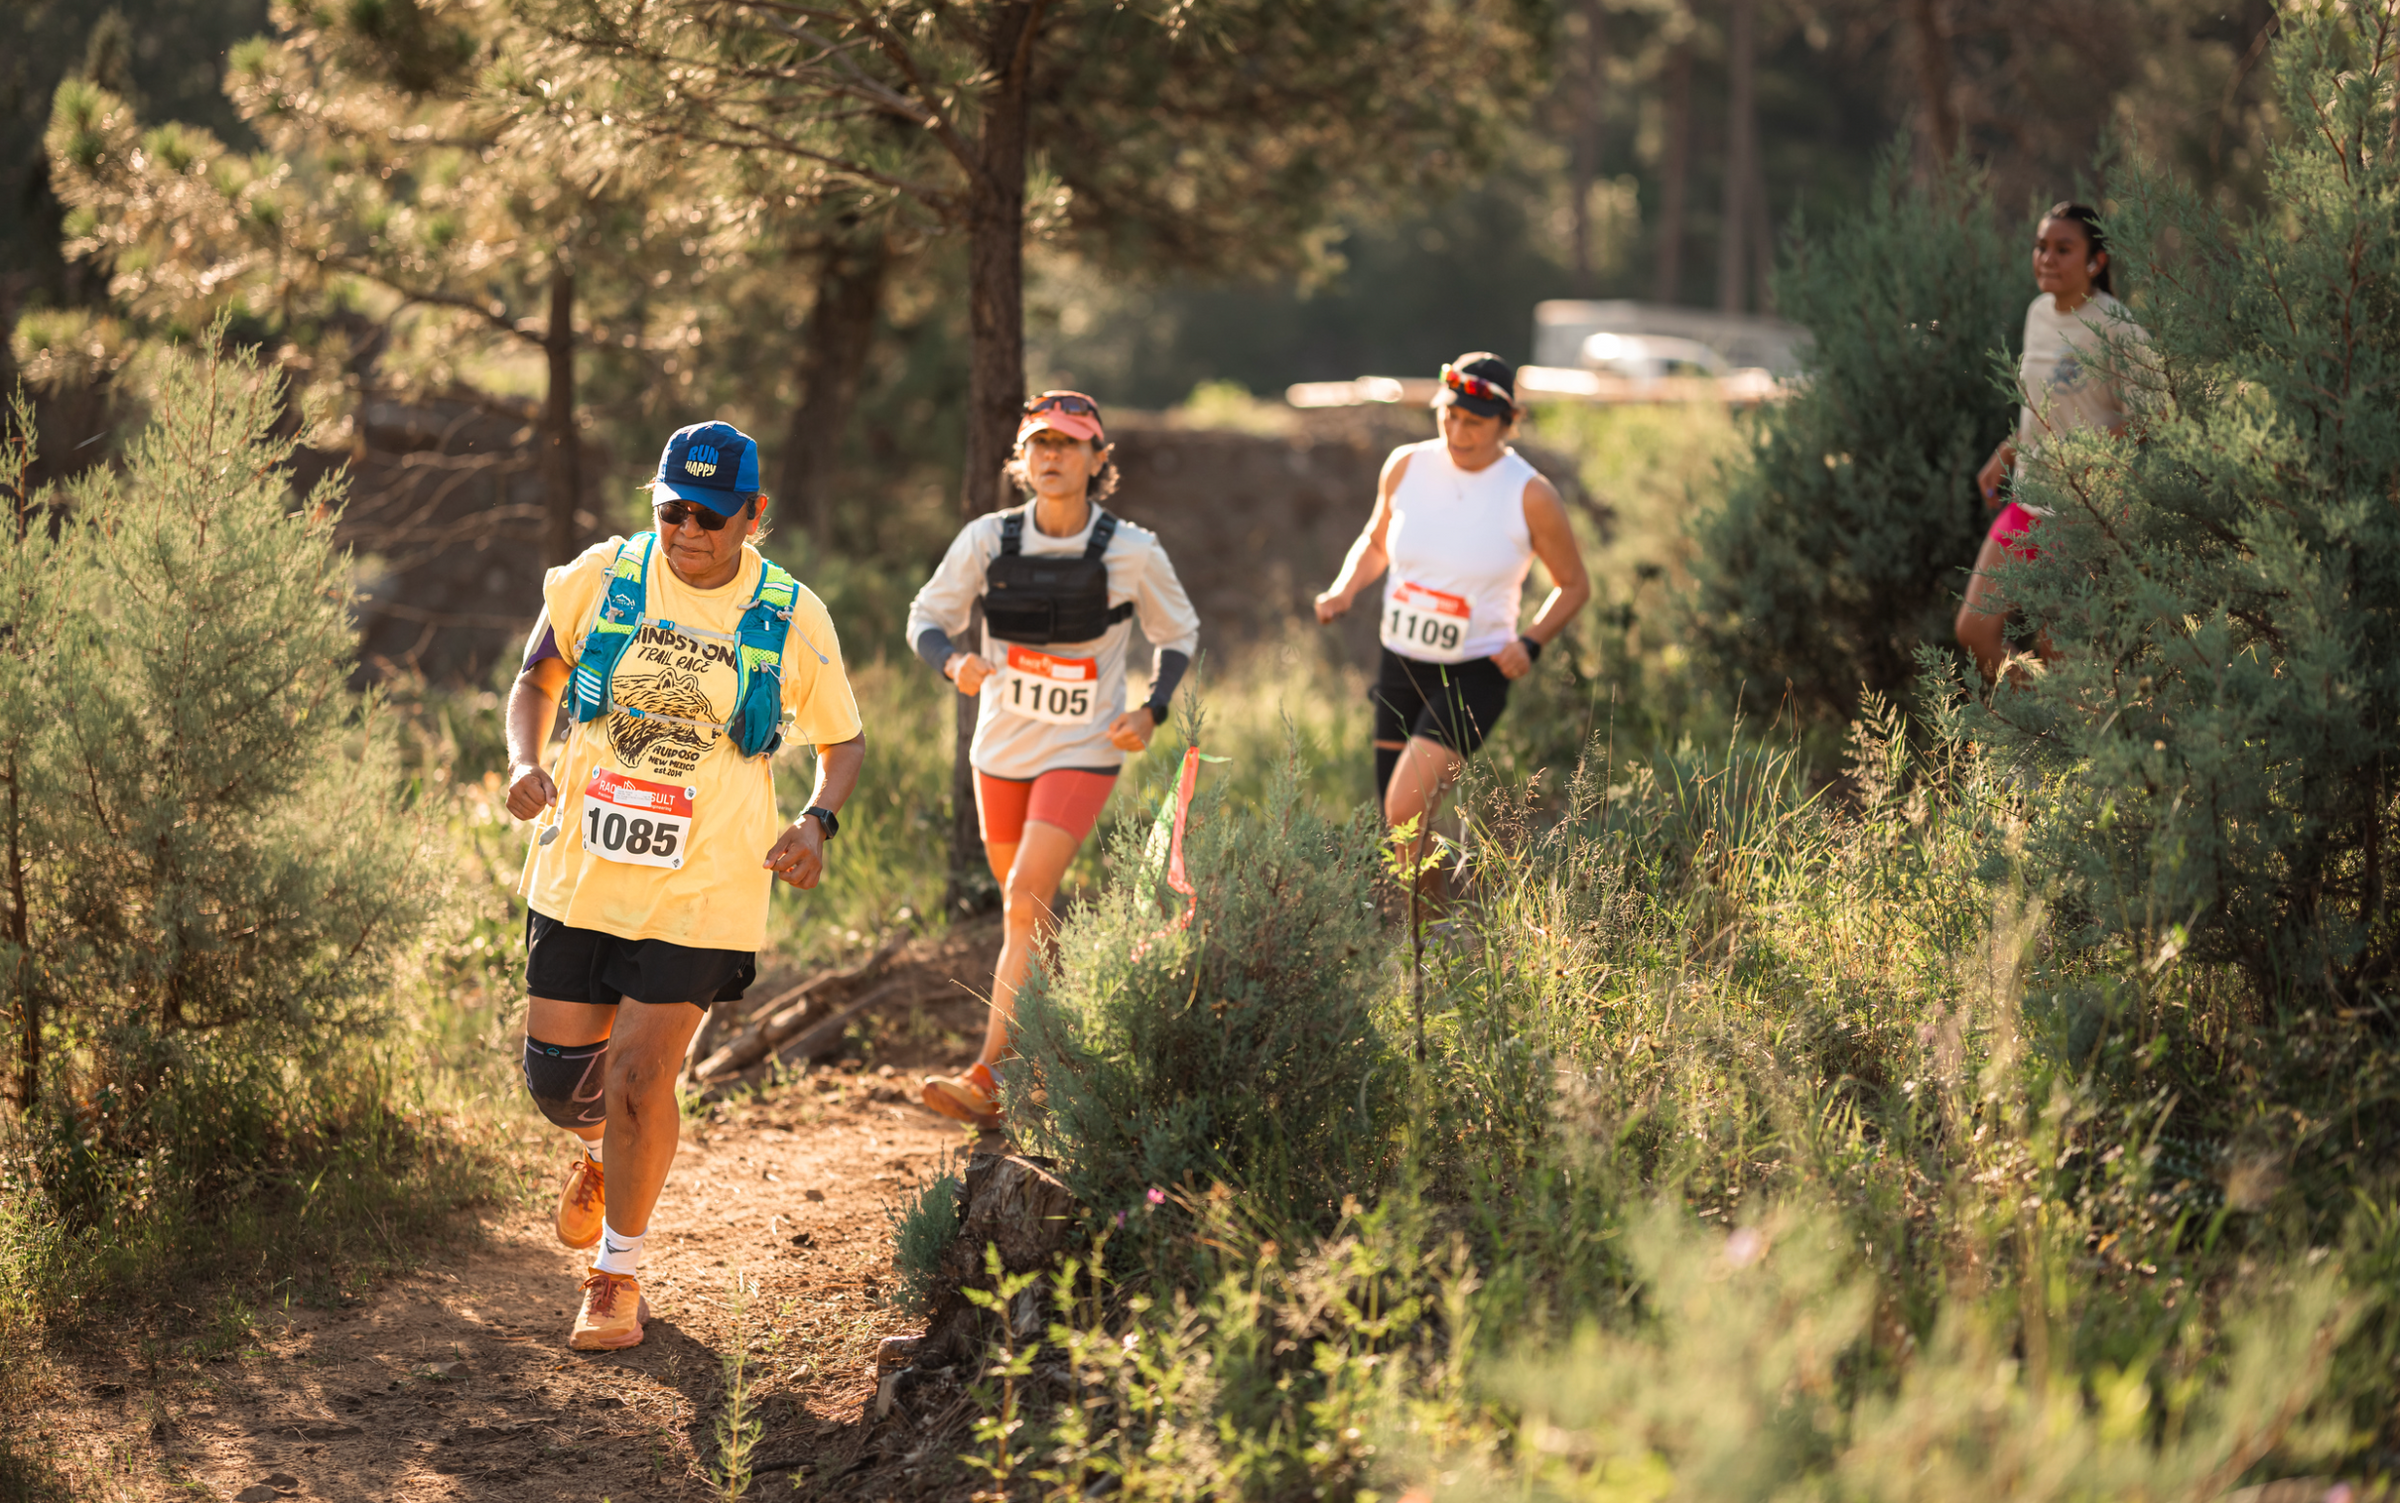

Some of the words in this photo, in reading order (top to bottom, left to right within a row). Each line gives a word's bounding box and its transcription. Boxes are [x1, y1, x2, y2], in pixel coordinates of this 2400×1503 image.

[687, 444, 719, 465] RUN
[684, 460, 717, 478] HAPPY
[1391, 608, 1460, 651] 1109
[637, 646, 673, 667] TRAIL
[676, 656, 713, 673] RACE
[1011, 678, 1089, 717] 1105
[648, 755, 668, 767] NEW
[669, 760, 696, 772] MEXICO
[599, 780, 622, 794] RAC
[588, 806, 680, 858] 1085
